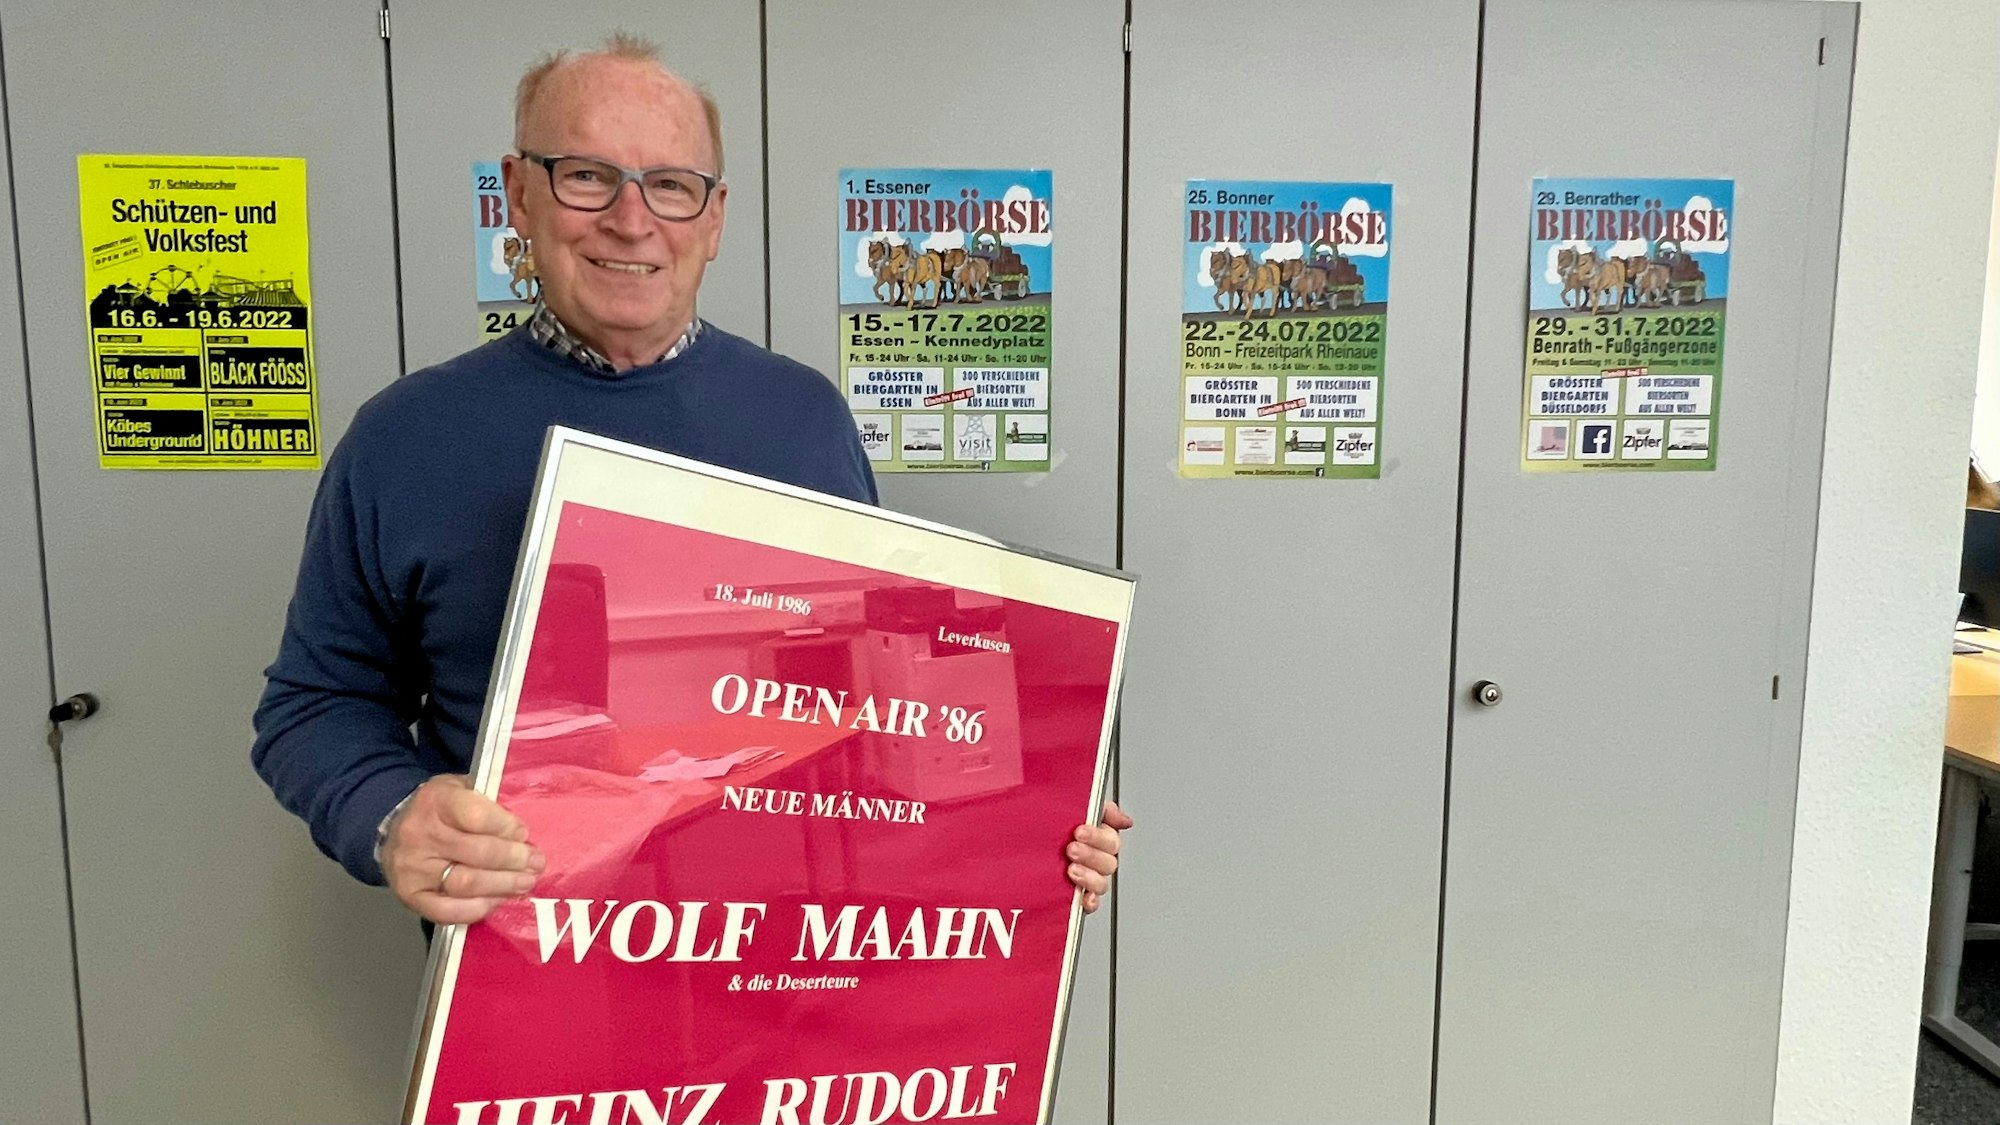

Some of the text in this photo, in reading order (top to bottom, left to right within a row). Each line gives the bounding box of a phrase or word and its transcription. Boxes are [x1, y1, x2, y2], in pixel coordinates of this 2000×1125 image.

[149, 179, 237, 191] 37. Schlebuscher
[478, 176, 502, 190] 22.
[846, 179, 931, 195] 1. Essener
[1188, 191, 1274, 205] 25. Bonner
[1537, 191, 1640, 206] 29. Benrather
[112, 198, 277, 224] Schützen- und
[845, 188, 1050, 234] BIERBÖRSE
[1189, 201, 1385, 245] BIERBÖRSE
[1536, 199, 1728, 242] BIERBÖRSE
[144, 228, 249, 253] Volksfest
[107, 310, 163, 328] 16.6.
[185, 310, 292, 328] 19.6.2022
[851, 334, 904, 347] Essen
[925, 334, 1045, 350] Kennedyplatz
[1533, 337, 1592, 354] Benrath
[1605, 337, 1717, 357] Fußgängerzone
[894, 354, 910, 362] Uhr
[961, 354, 977, 362] Uhr
[1030, 354, 1047, 362] Uhr
[1186, 342, 1221, 358] Bonn
[1235, 343, 1312, 361] Freizeitpark
[1316, 344, 1378, 359] Rheinaue
[103, 364, 130, 380] Vier
[210, 357, 306, 385] BLÄCK FÖÖSS
[868, 369, 923, 382] GRÖSSTER
[982, 371, 1040, 381] VERSCHIEDENE
[976, 384, 1025, 394] BIERSORTEN
[1205, 378, 1258, 391] GRÖSSTER
[1315, 380, 1371, 390] VERSCHIEDENE
[1549, 376, 1603, 388] GRÖSSTER
[854, 385, 938, 395] BIERGARTEN IN
[1541, 391, 1608, 401] BIERGARTEN
[880, 398, 912, 408] ESSEN
[967, 398, 982, 408] AUS
[986, 398, 1009, 408] ALLER
[1190, 394, 1272, 404] BIERGARTEN IN
[1309, 394, 1357, 404] BIERSORTEN
[1215, 408, 1246, 418] BONN
[1318, 408, 1340, 418] ALLER
[1542, 402, 1607, 413] DÜSSELDORFS
[107, 419, 152, 433] Köbes
[107, 433, 203, 450] Underground
[214, 424, 310, 450] HÖHNER
[860, 430, 890, 444] ipfer
[959, 437, 992, 448] visit
[1623, 435, 1662, 451] Zipfer
[1336, 439, 1373, 453] Zipfer
[713, 583, 812, 616] 18. Juli 1986
[937, 626, 1011, 654] Leverkusen
[710, 673, 847, 729] OPEN
[849, 693, 930, 739] AIR
[719, 785, 927, 825] NEUE MÄNNER
[529, 897, 1023, 964] WOLF MAAHN
[727, 972, 859, 992] & die Deserteure
[758, 1062, 1017, 1125] RUDOLF
